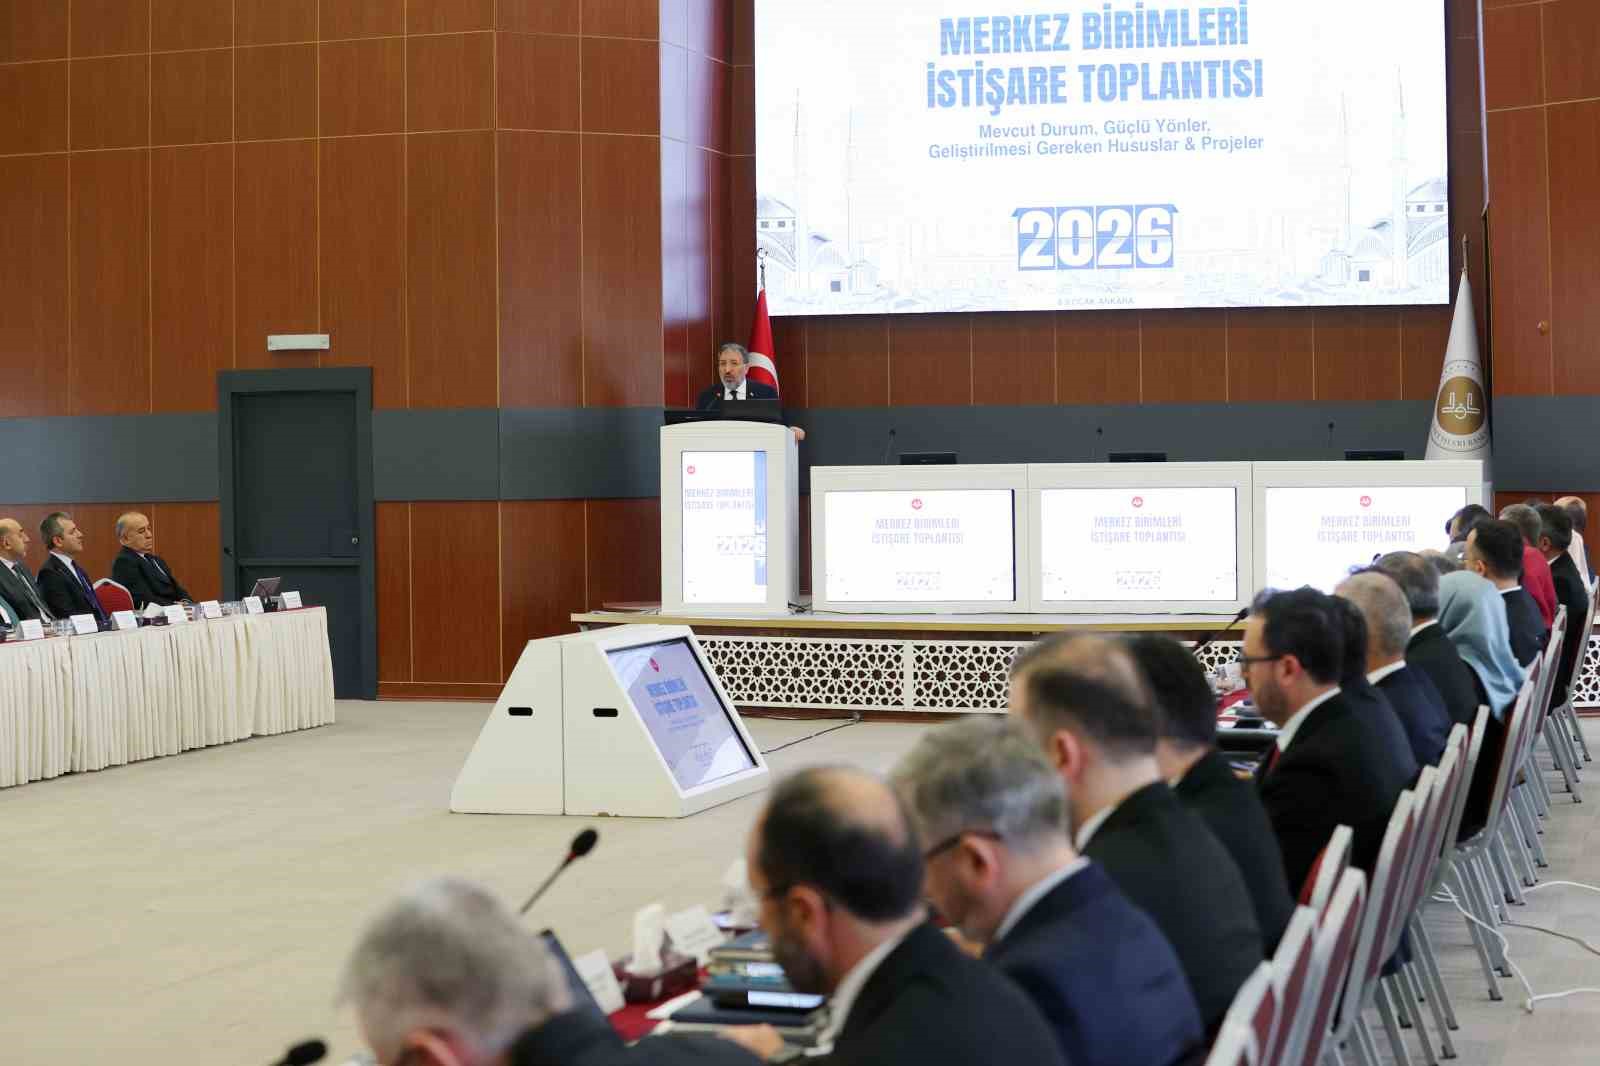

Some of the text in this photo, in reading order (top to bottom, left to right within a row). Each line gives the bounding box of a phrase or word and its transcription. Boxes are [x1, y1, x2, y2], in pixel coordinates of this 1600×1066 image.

[940, 0, 1248, 55] MERKEZ BİRİMLERİ
[927, 58, 1264, 116] İSTİŞARE TOPLANTISI
[928, 135, 1264, 161] Geliştirilmesi Gereken Hususlar & Projeler
[978, 124, 1036, 138] Mevcut
[1103, 118, 1151, 136] Güçlü
[1018, 205, 1174, 270] 2026
